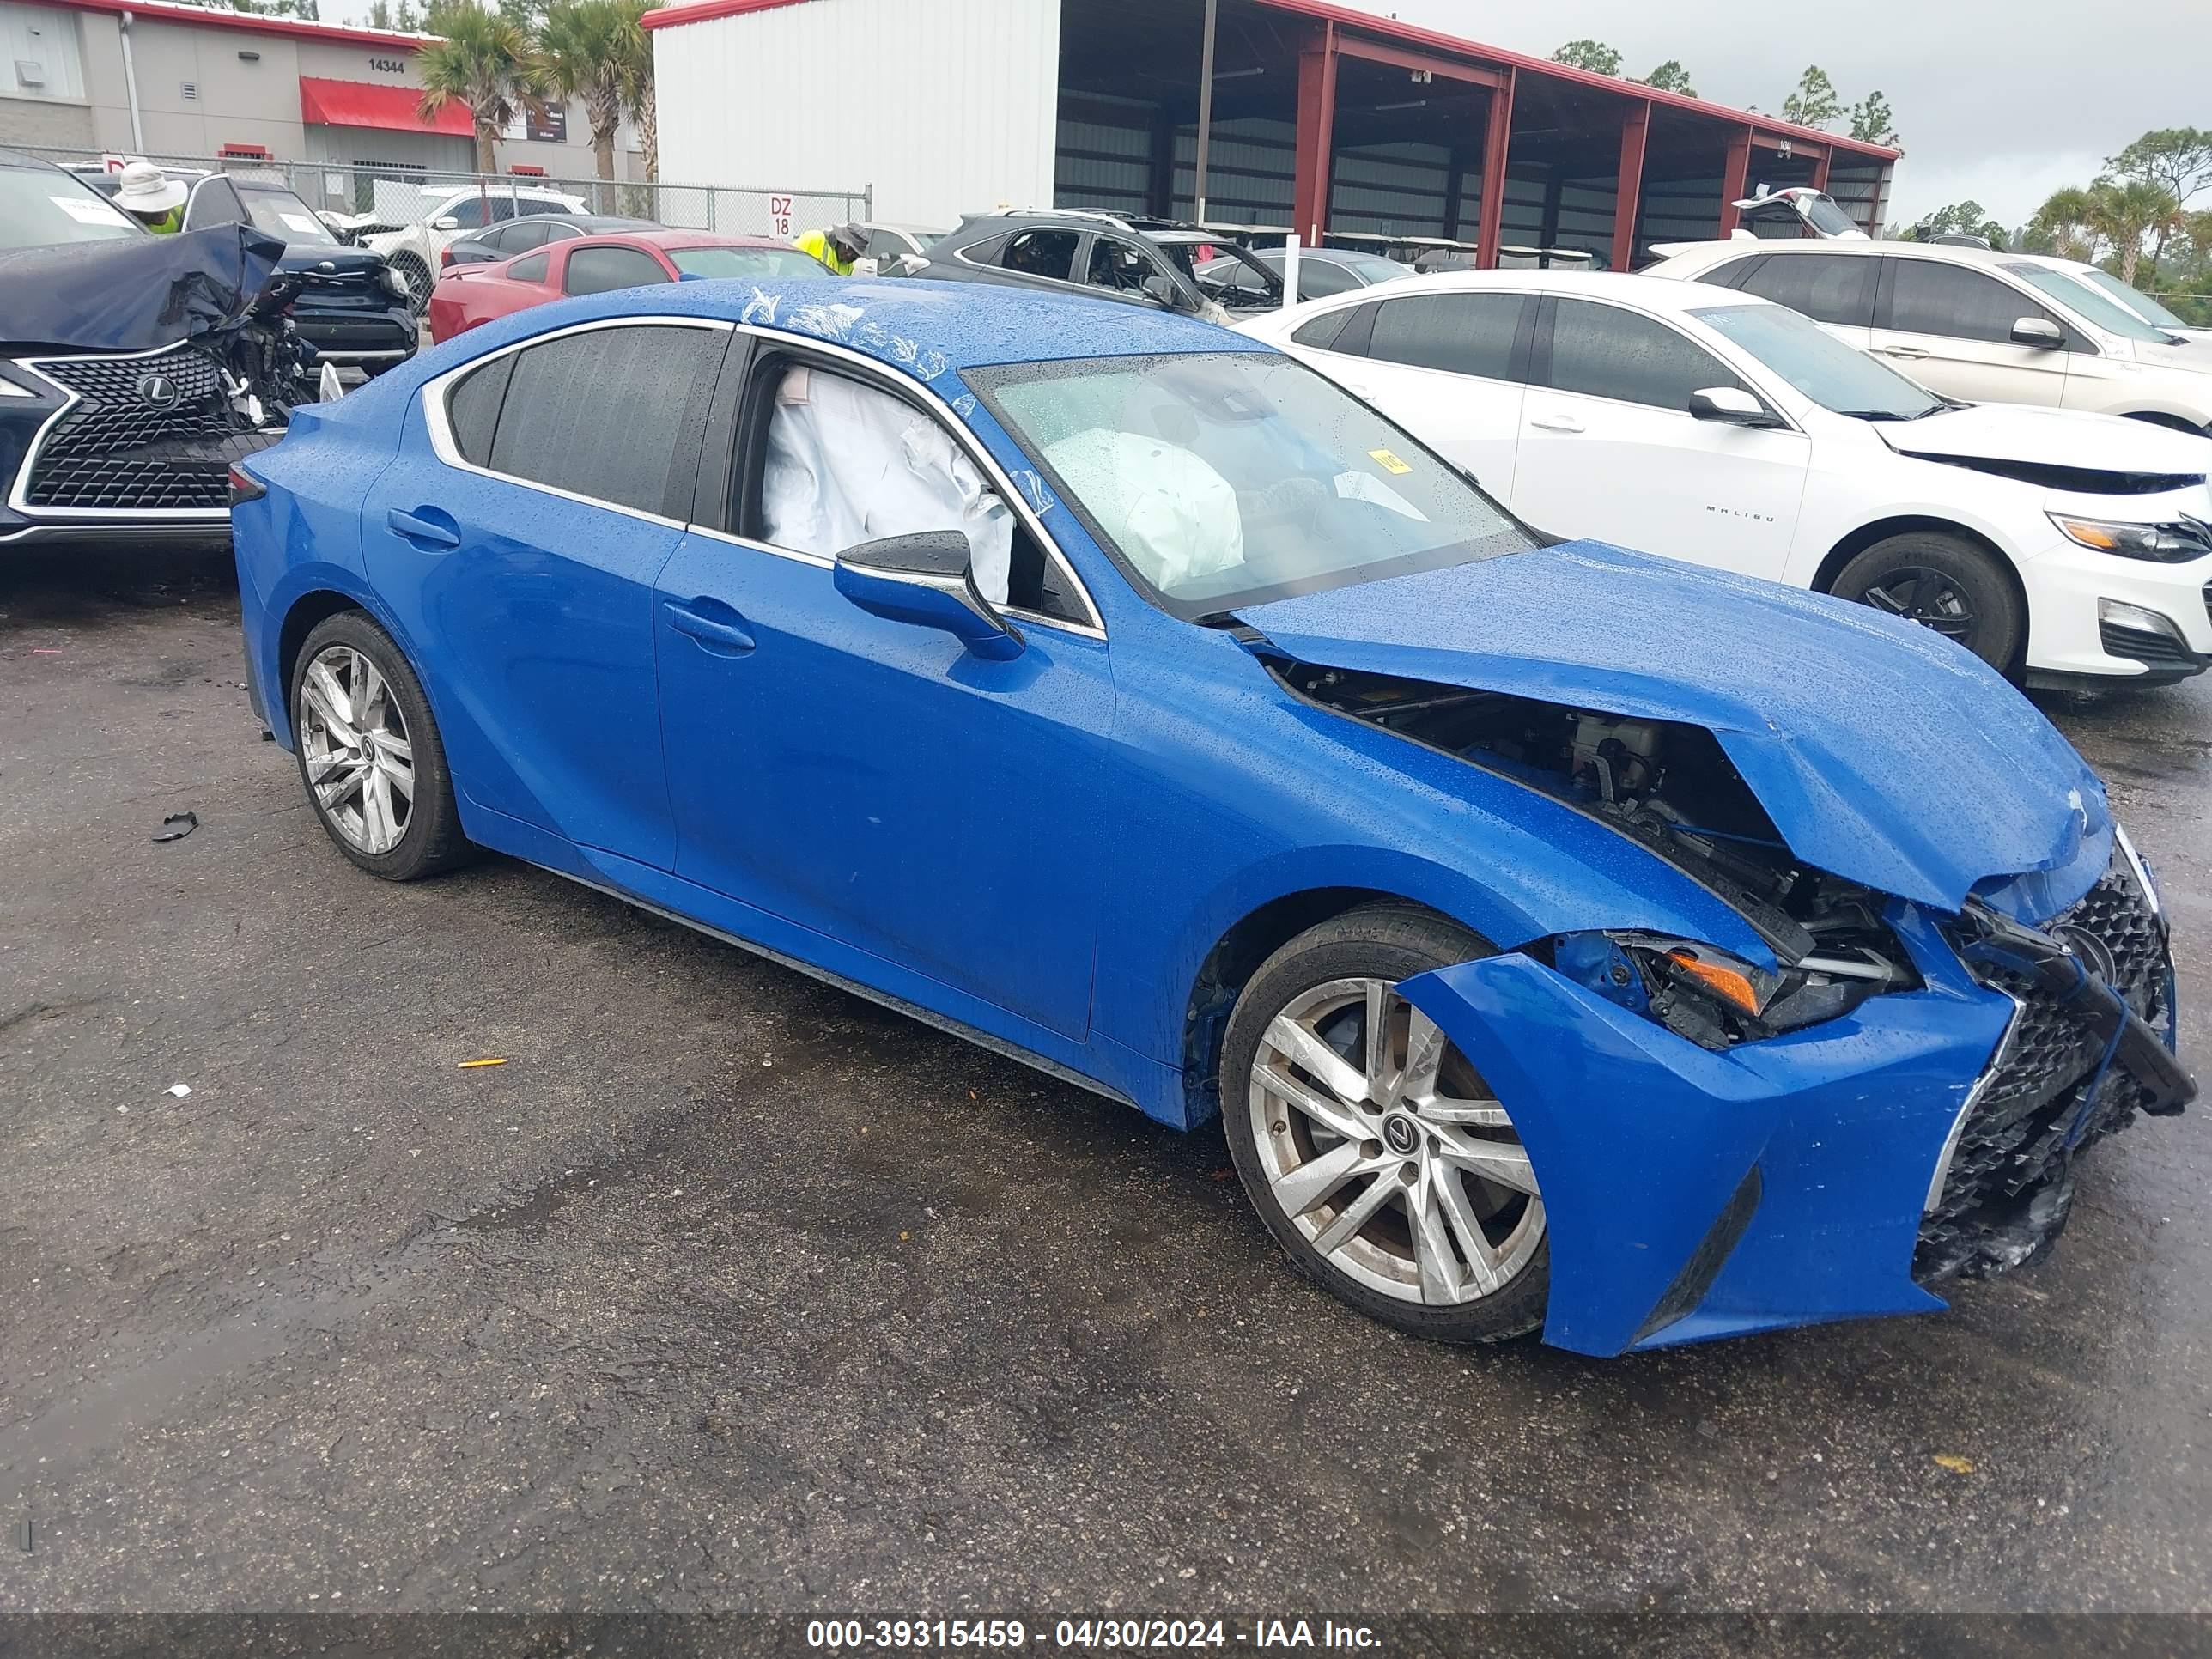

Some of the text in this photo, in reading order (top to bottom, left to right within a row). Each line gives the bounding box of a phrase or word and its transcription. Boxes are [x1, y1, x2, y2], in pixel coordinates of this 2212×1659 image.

[368, 58, 405, 75] 14344
[771, 197, 792, 216] DZ
[775, 217, 789, 235] 18
[1705, 505, 1775, 523] MALIBU
